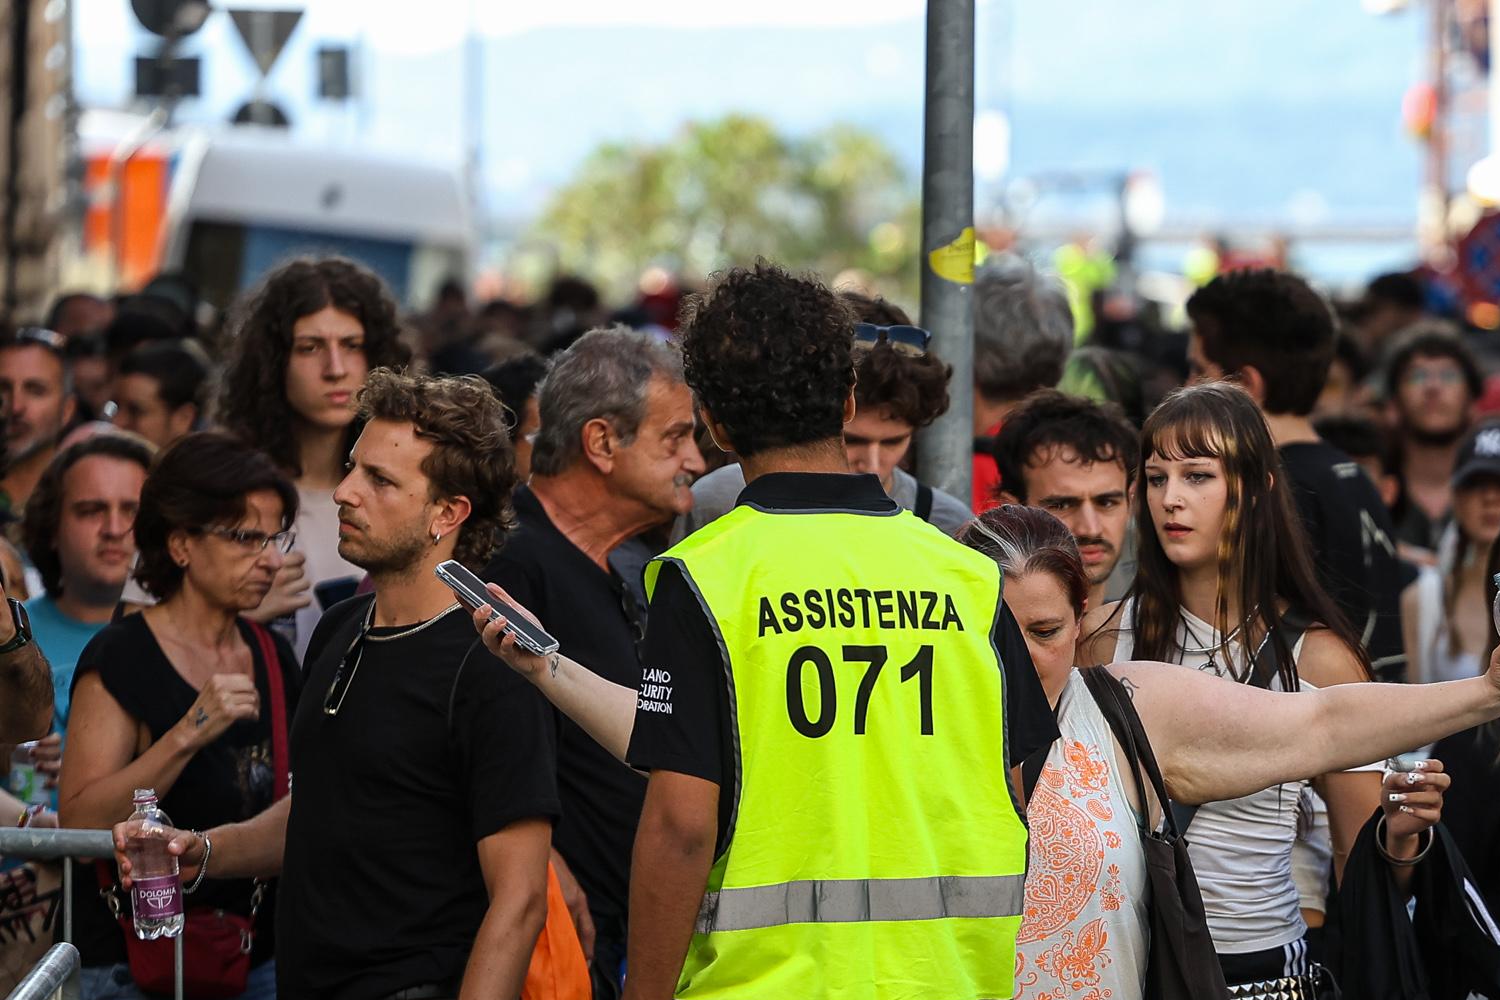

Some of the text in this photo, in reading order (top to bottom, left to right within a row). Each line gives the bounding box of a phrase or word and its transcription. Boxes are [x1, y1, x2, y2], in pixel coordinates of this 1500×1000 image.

[758, 588, 965, 637] ASSISTENZA
[786, 645, 934, 738] 071
[140, 886, 177, 898] DOLOMIA
